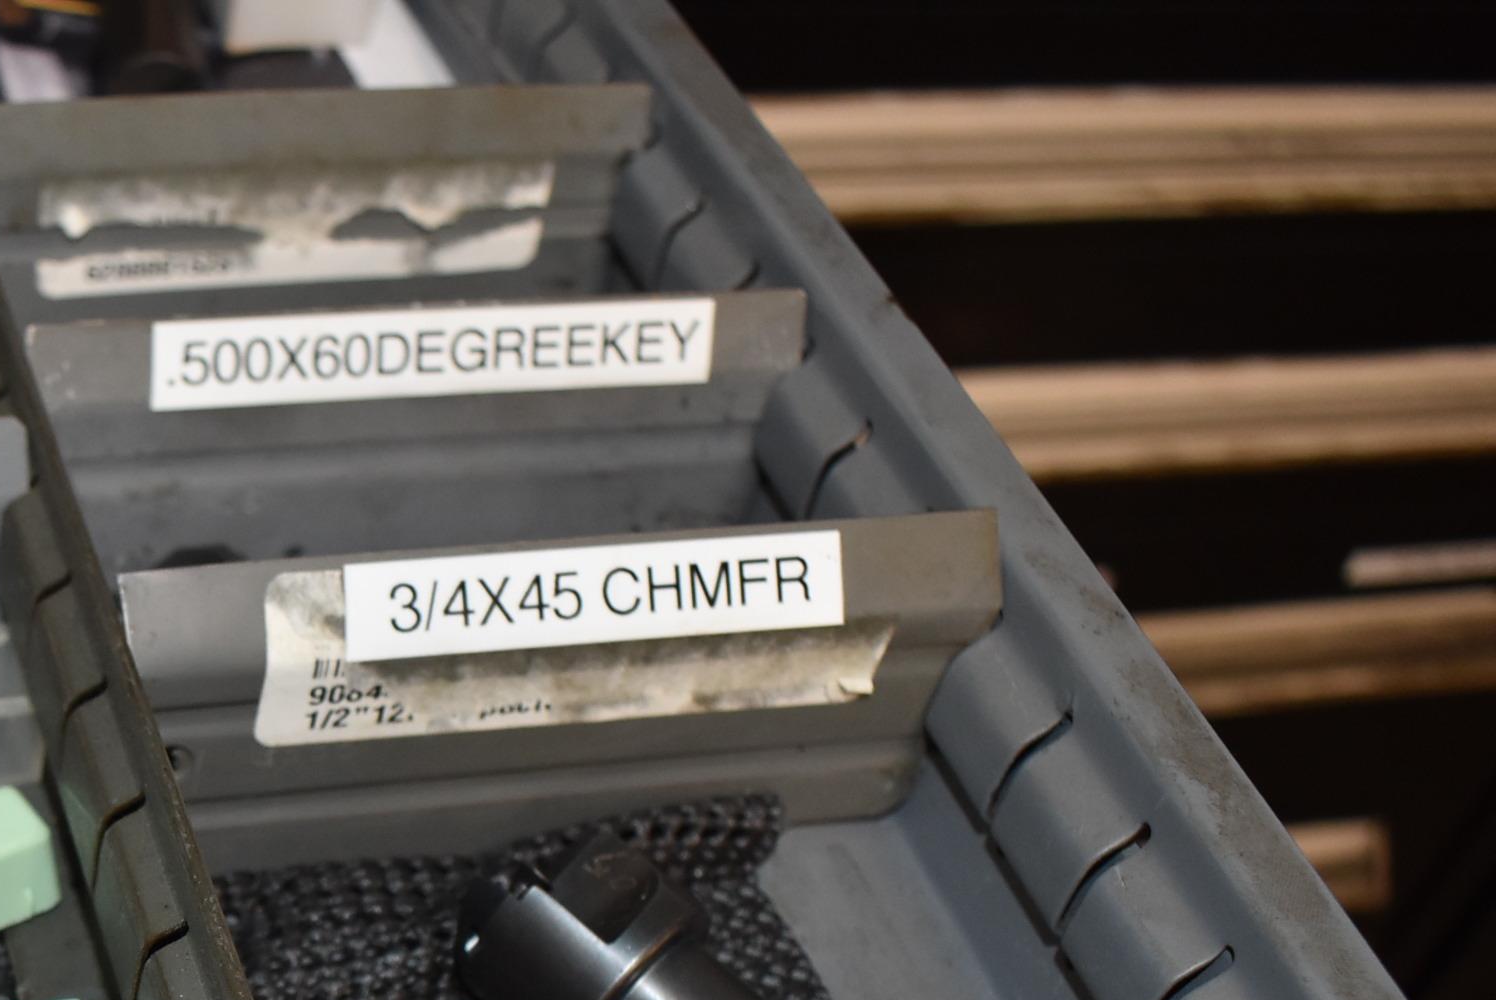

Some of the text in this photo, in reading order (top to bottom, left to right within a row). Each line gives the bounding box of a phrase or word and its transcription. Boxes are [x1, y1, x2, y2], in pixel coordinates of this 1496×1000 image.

[166, 320, 701, 387] .500X60DEGREEKEY
[388, 556, 812, 632] 3/4X45 CHMFR
